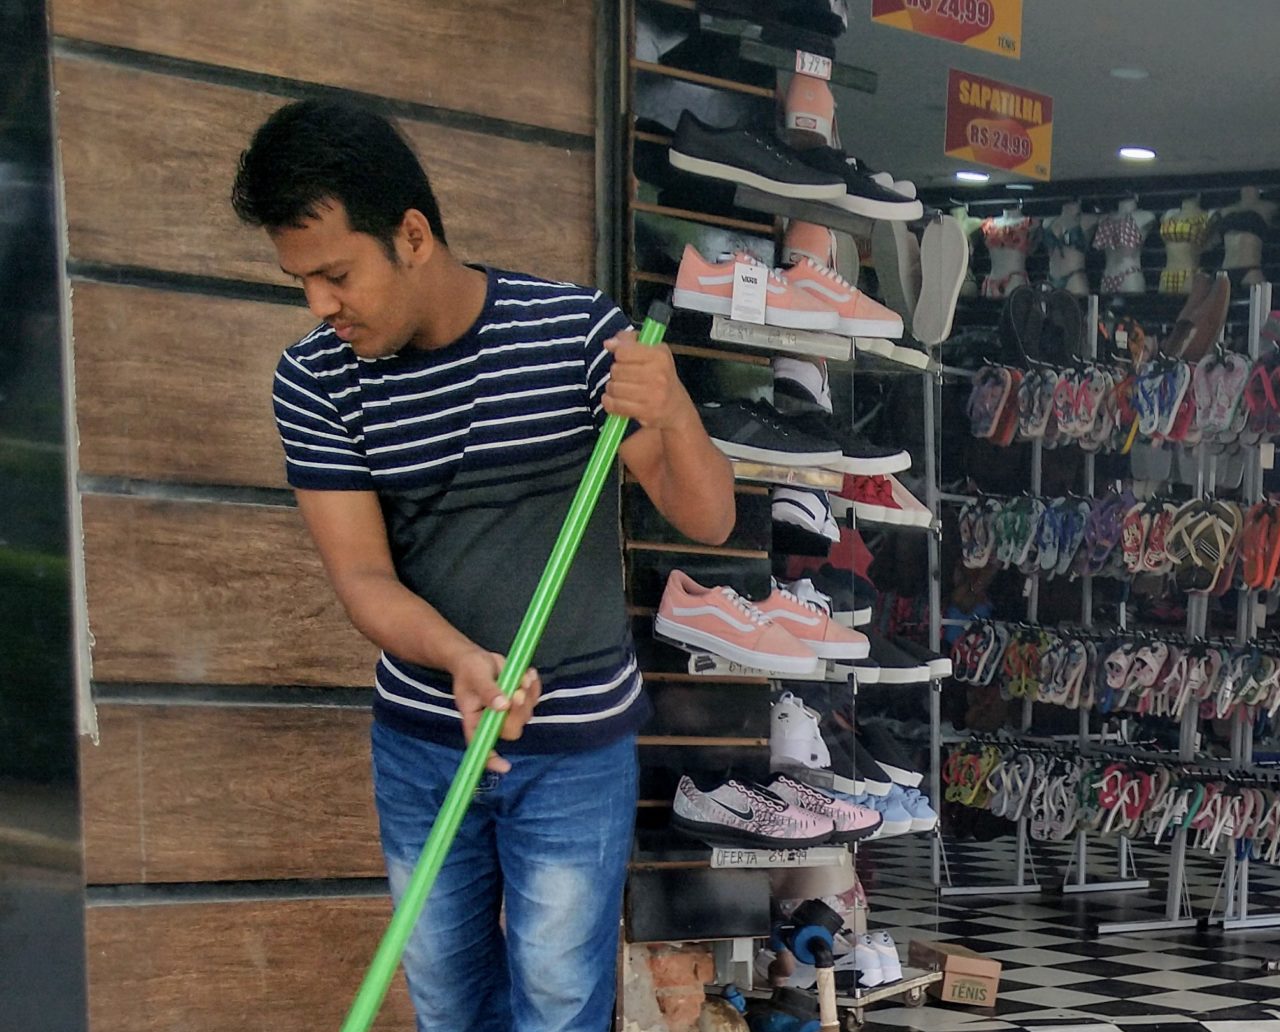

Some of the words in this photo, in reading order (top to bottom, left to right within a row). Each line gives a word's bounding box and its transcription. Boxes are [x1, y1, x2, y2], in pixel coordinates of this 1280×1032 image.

[936, 0, 990, 27] 24,99
[959, 79, 1042, 124] SAPATILHA
[741, 275, 758, 285] VANS
[717, 850, 758, 865] OFERTA
